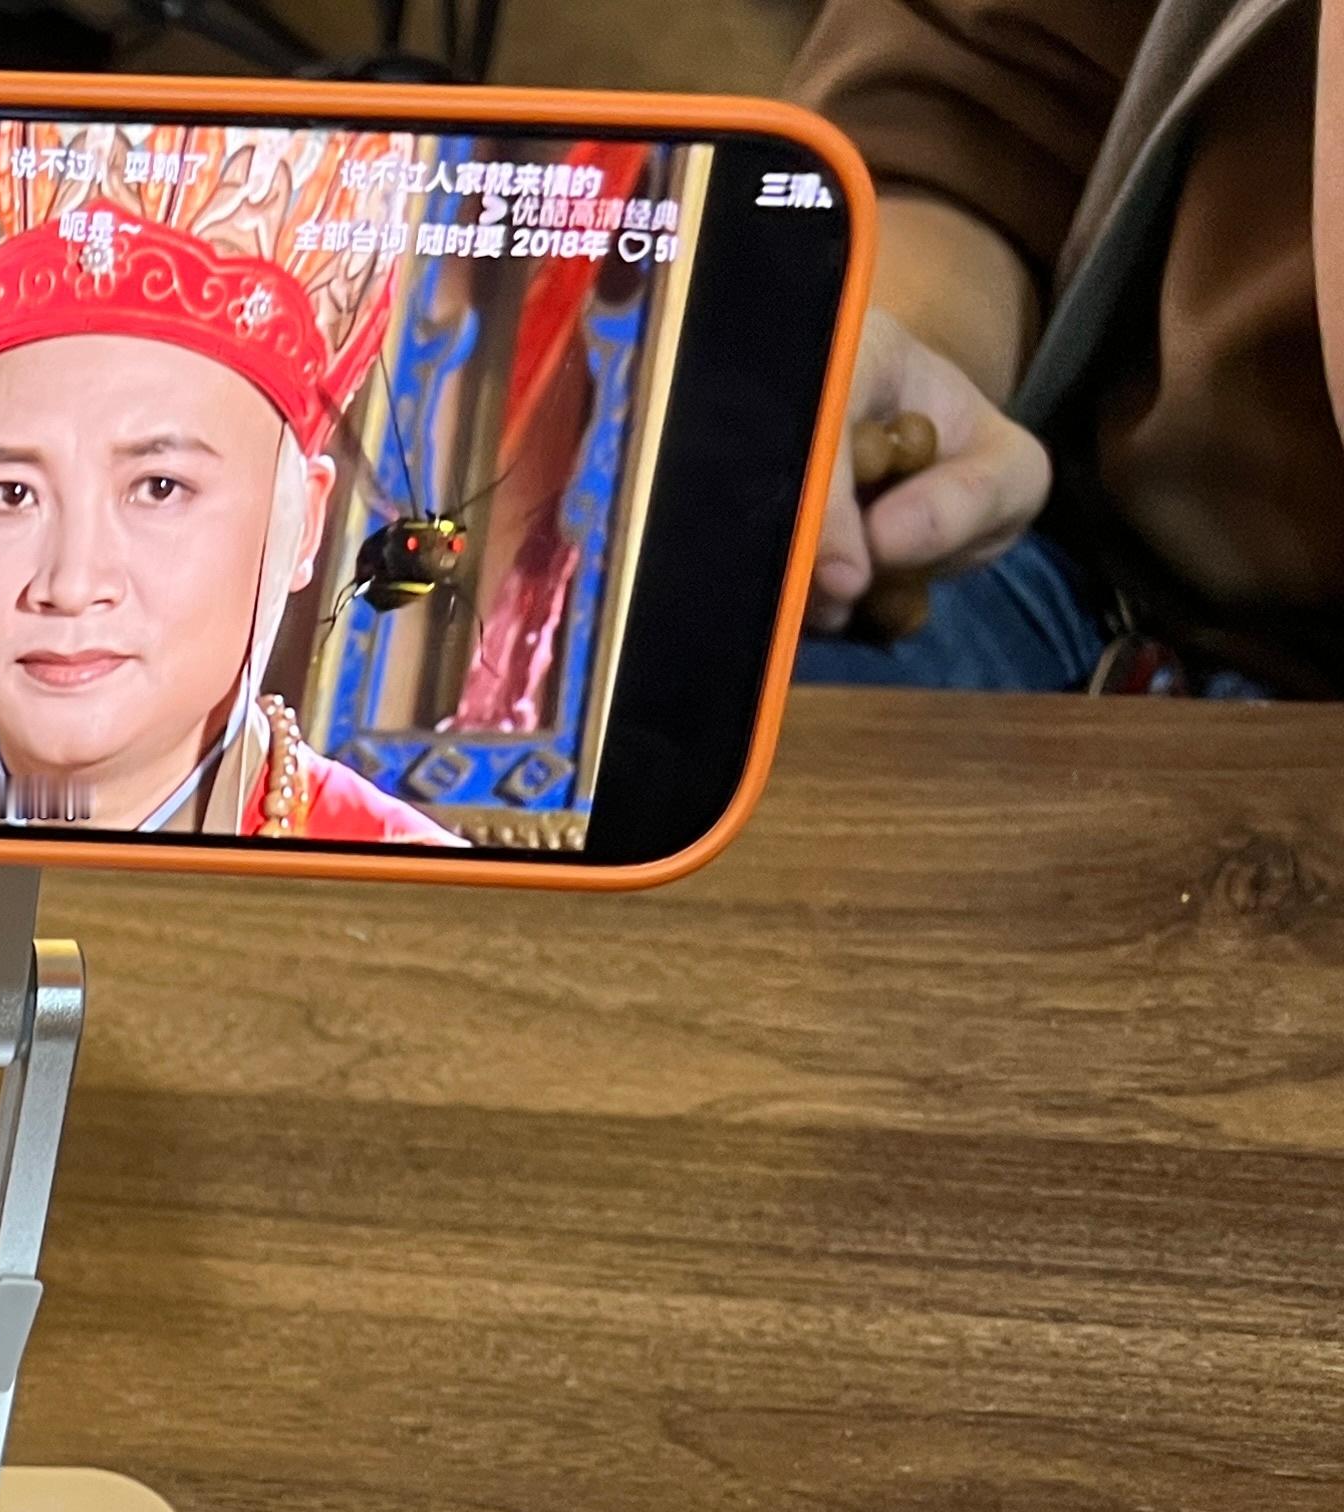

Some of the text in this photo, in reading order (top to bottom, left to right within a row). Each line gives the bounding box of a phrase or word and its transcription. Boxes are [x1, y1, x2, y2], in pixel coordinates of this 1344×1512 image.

[340, 159, 604, 198] 说不过人家就来横的
[512, 197, 679, 231] 优酷高清经典
[294, 220, 408, 255] 全部台词
[510, 228, 610, 261] 2018年
